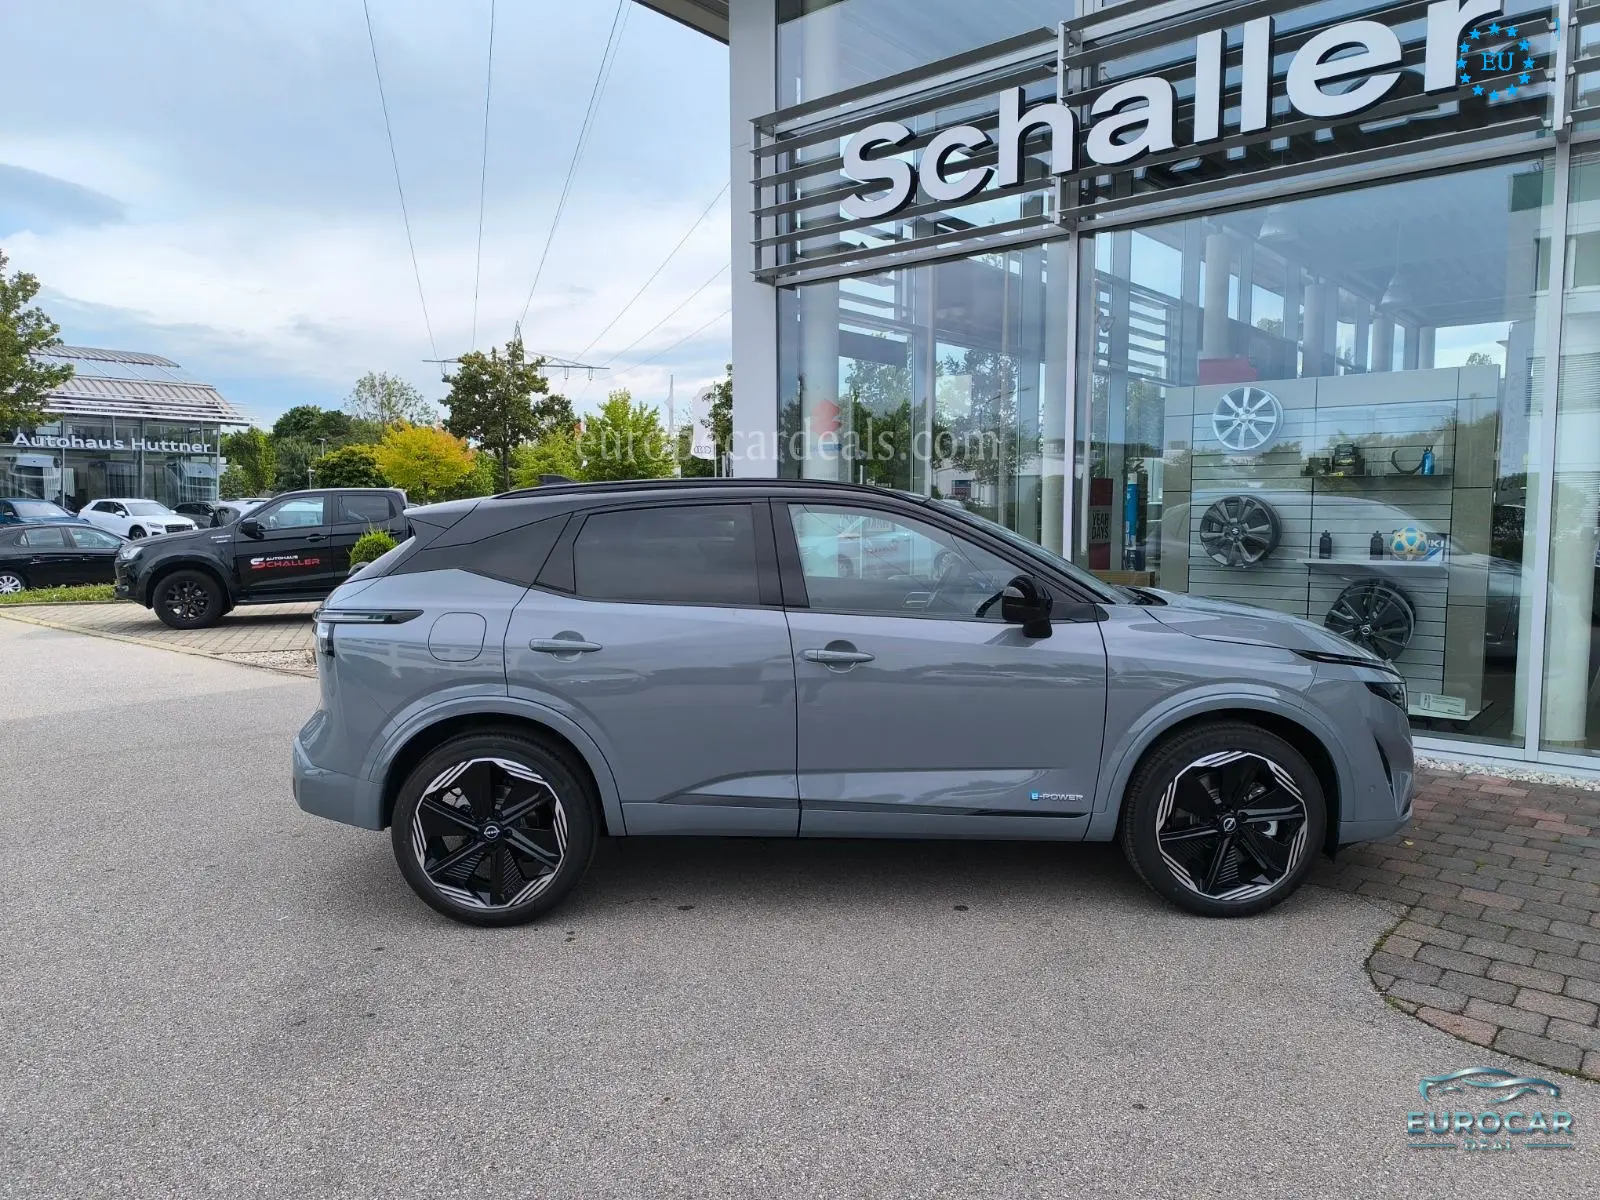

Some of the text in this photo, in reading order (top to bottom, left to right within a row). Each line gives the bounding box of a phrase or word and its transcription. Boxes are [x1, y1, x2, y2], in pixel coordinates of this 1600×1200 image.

[838, 0, 1504, 219] Schaller
[12, 432, 124, 450] Autohaus
[1091, 527, 1108, 539] DAYS
